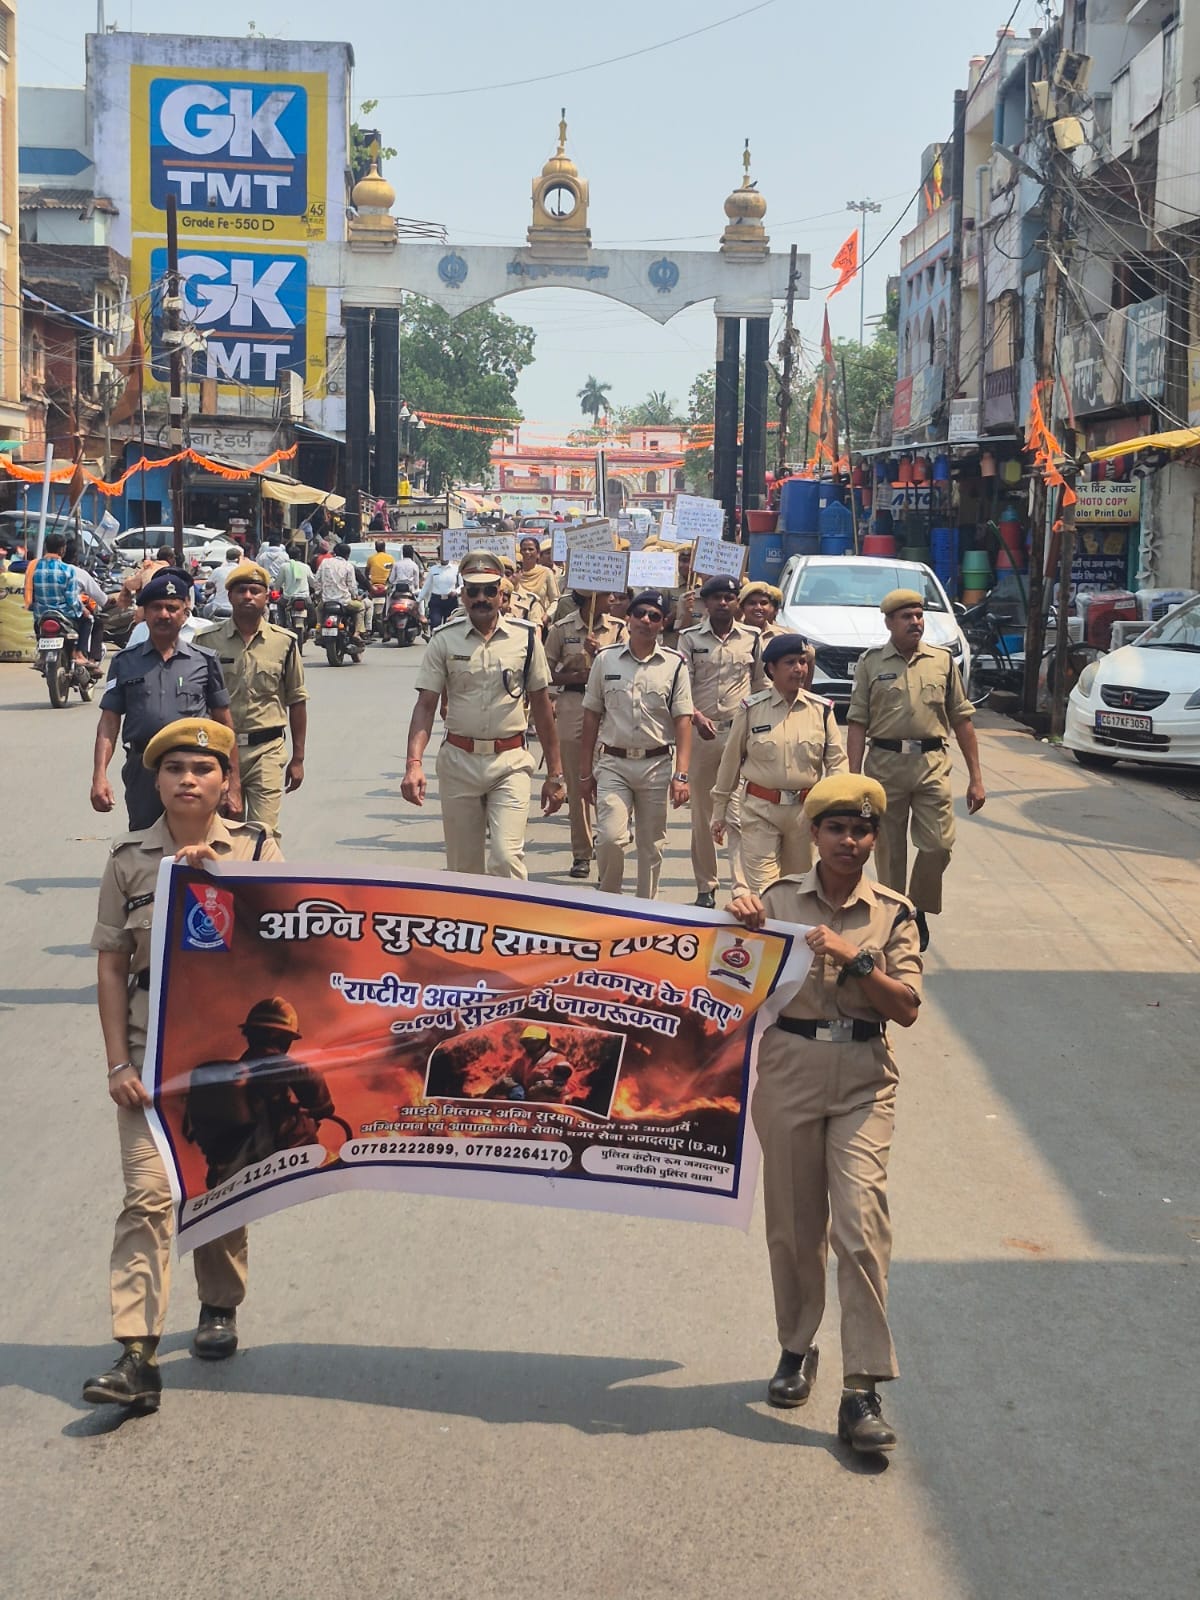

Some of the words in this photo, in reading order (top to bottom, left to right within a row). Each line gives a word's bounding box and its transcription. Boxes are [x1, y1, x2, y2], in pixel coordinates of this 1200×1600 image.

[160, 84, 296, 159] GK
[167, 171, 291, 209] TMT
[182, 216, 215, 229] Grade
[217, 217, 260, 231] Fe-550
[262, 219, 275, 231] D
[176, 255, 296, 329] GK
[203, 342, 290, 381] MT
[1079, 497, 1102, 506] HOTO
[1105, 497, 1127, 506] COPY
[1094, 509, 1114, 517] Print
[1117, 509, 1131, 517] Out
[258, 900, 366, 940] अग्नि
[373, 913, 486, 954] सुरक्षा
[610, 934, 699, 961] 2026
[577, 969, 654, 998] विकास
[661, 981, 684, 1002] के
[529, 988, 549, 1010] में
[555, 996, 680, 1036] जागरूकता
[496, 1107, 532, 1120] अग्नि
[536, 1111, 574, 1125] सुरक्षा
[361, 1119, 424, 1133] अग्निशमन
[428, 1119, 445, 1132] एवं
[626, 1134, 685, 1151] जगदलपुर
[351, 1143, 459, 1157] 07782222899,
[465, 1144, 568, 1162] 07782264170
